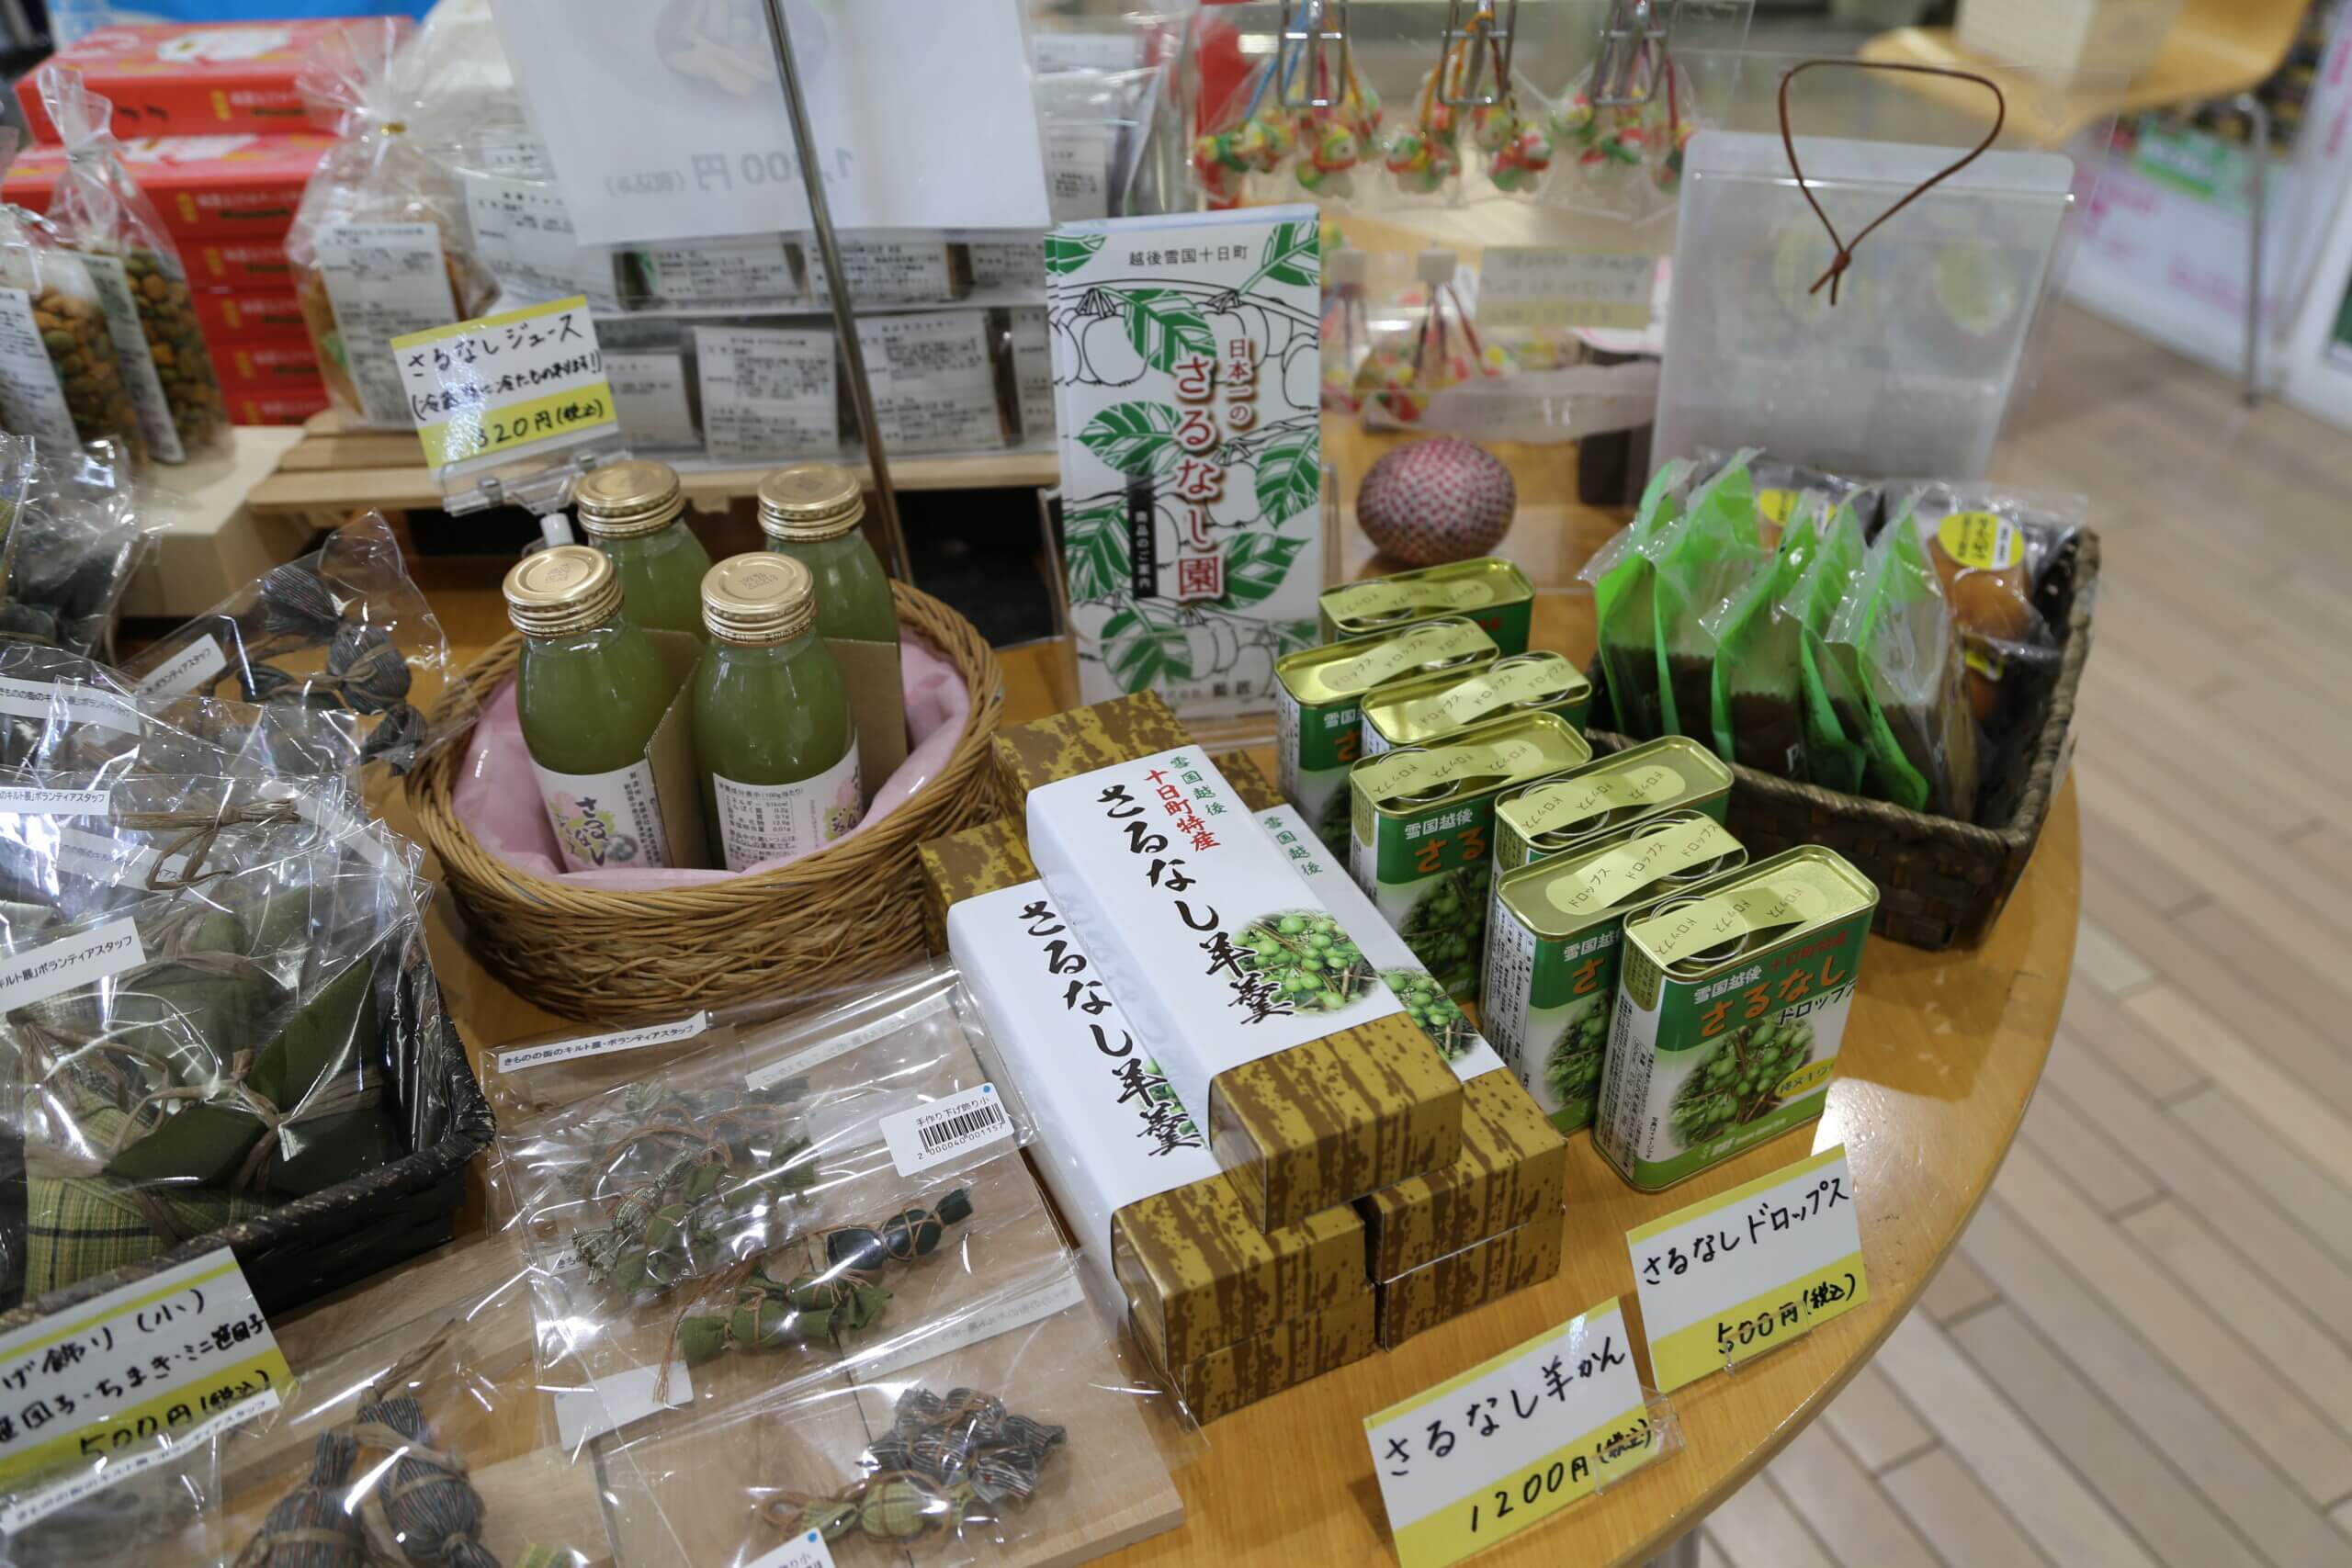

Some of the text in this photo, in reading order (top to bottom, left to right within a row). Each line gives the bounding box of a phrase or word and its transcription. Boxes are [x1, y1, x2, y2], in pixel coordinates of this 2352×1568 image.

[1129, 245, 1249, 266] 越後雪国十日町
[408, 313, 583, 378] さるなしジュース
[1227, 338, 1250, 423] 日本一の
[1176, 355, 1219, 596] さるなし園
[1324, 708, 1362, 729] 雪国
[1144, 770, 1221, 852] 十日町特産
[1170, 756, 1227, 816] 雪国越後
[1263, 815, 1322, 876] 雪国越後
[1405, 807, 1475, 840] 雪国越後
[1415, 827, 1487, 874] さる
[1680, 823, 1722, 858] ドロップス
[1567, 866, 1611, 908] ドロップス
[1624, 840, 1669, 880] ドロップス
[1097, 784, 1295, 1025] さるなし羊羹
[1712, 898, 1753, 934] ドロップス
[1654, 917, 1698, 955] ドロップス
[1572, 958, 1605, 995] さ
[1694, 964, 1762, 1005] 雪国越後
[1701, 954, 1847, 1038] さるなし
[1018, 900, 1203, 1156] さるなし羊羹
[1643, 1177, 1850, 1286] さるなしドロップス
[1717, 1272, 1857, 1355] 500円(税込)
[1384, 1336, 1626, 1477] さるなし羊かん
[1470, 1418, 1654, 1533] 1200円(税込)
